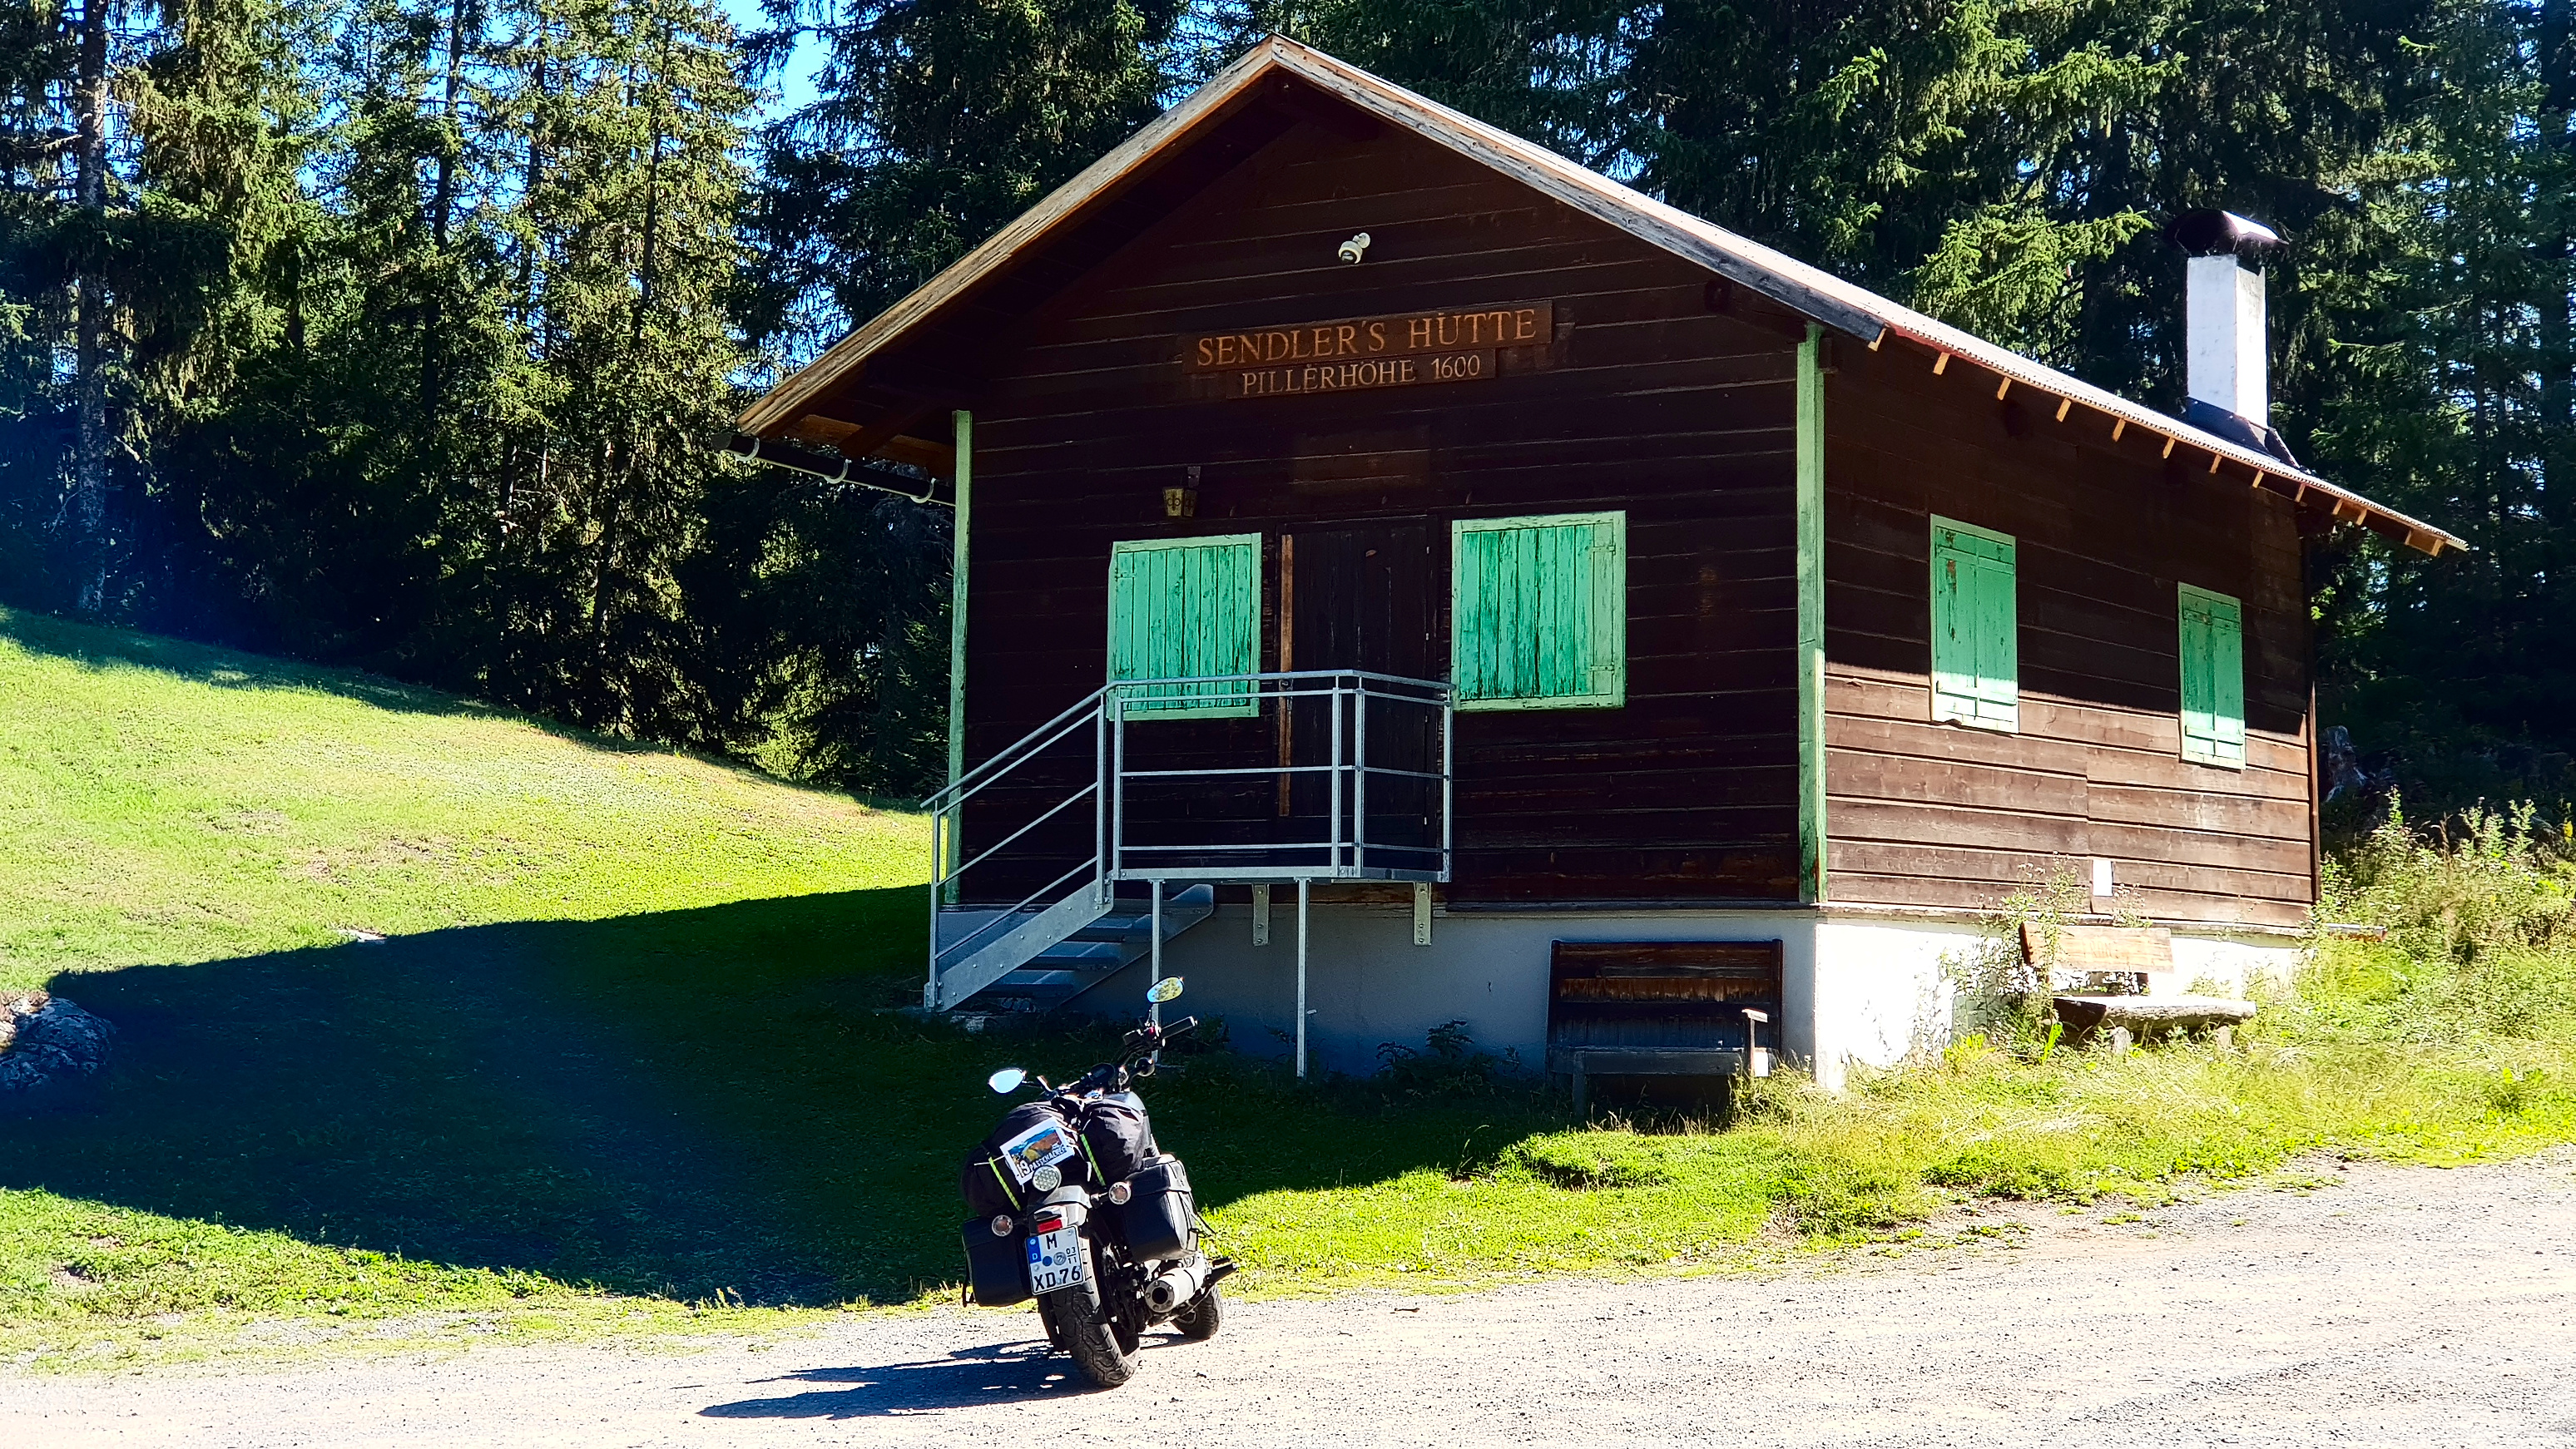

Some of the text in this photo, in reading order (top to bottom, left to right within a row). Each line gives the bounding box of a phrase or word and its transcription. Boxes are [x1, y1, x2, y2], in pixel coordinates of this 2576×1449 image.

[1196, 310, 1537, 367] SENDLER'S HÜTTE
[1241, 354, 1481, 395] PILLERHÖHE 1600
[1045, 1233, 1058, 1250] M
